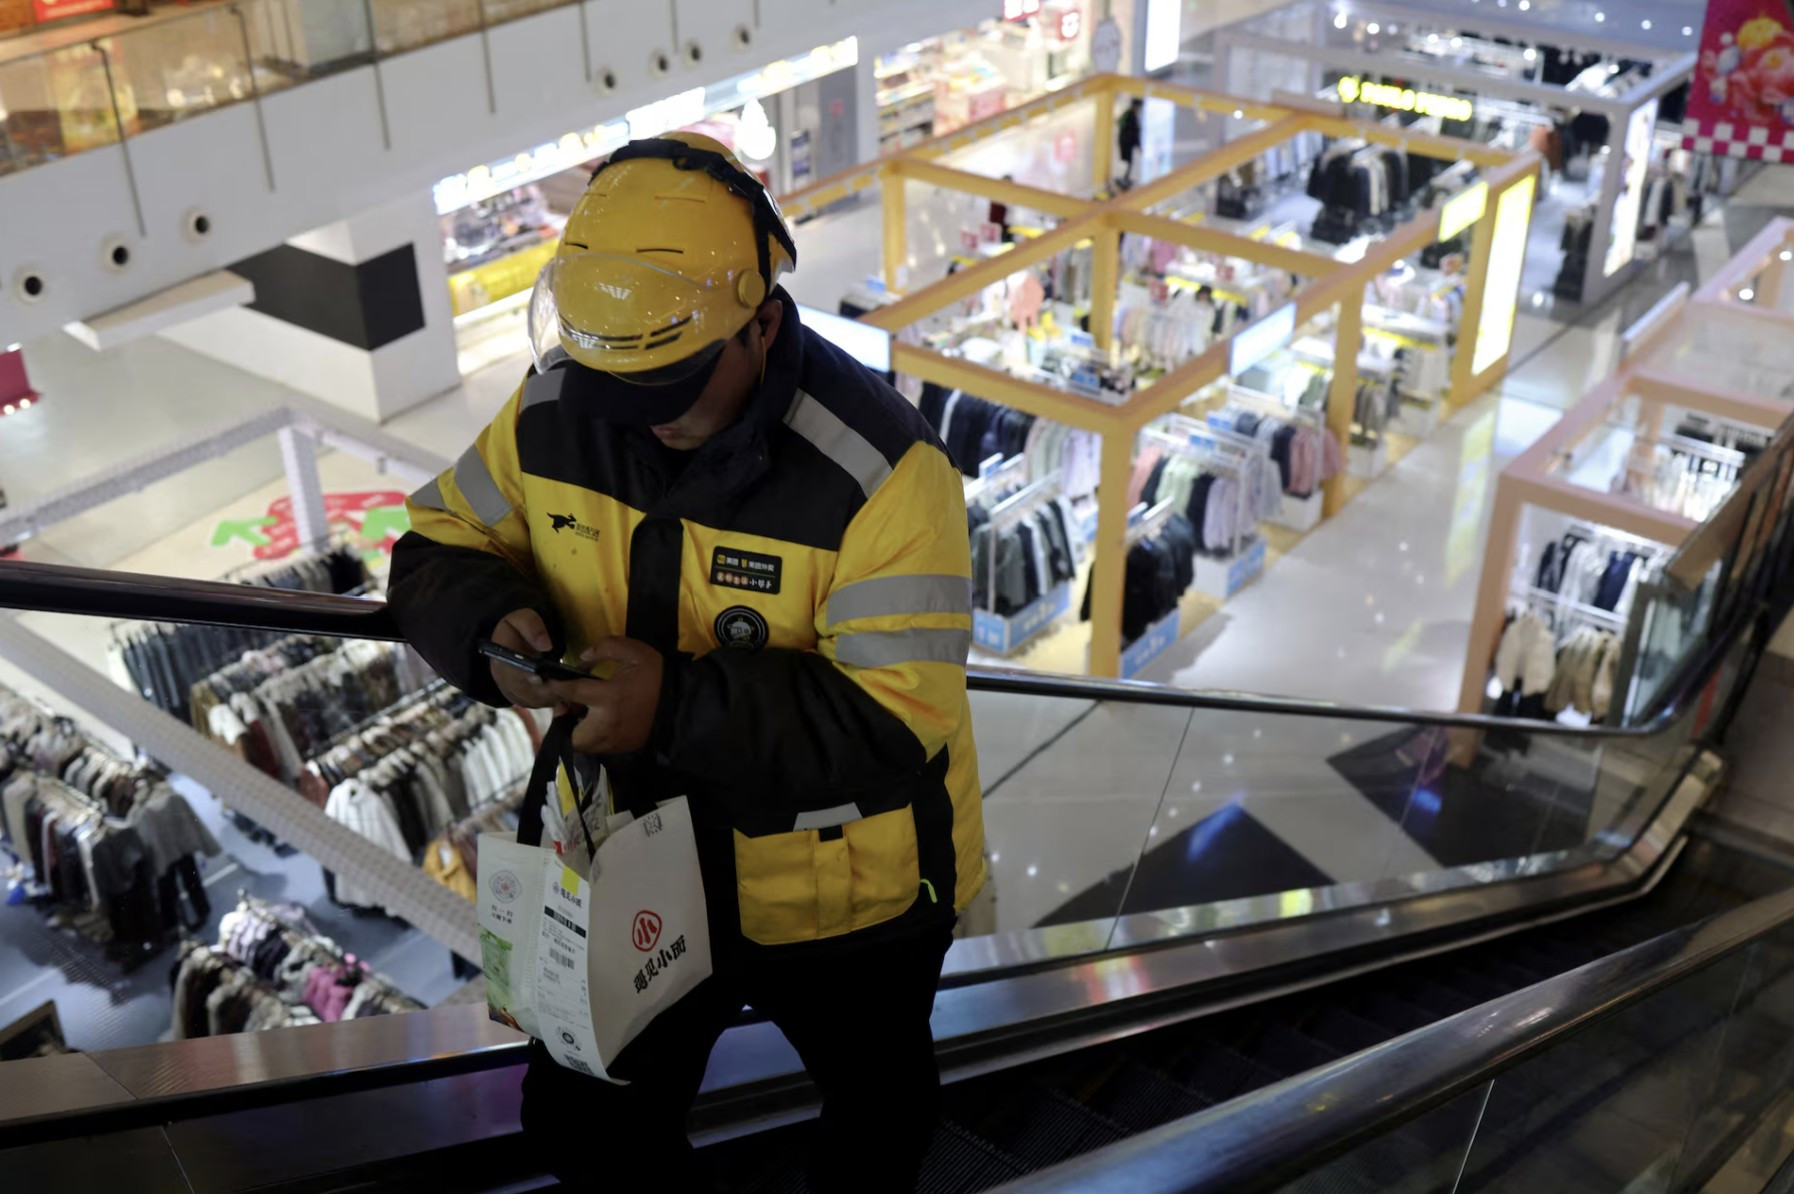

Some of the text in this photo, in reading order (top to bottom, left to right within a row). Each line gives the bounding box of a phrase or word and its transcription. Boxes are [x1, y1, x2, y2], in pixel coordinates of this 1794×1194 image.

[637, 918, 657, 946] 小
[634, 934, 686, 994] 遇见小面
